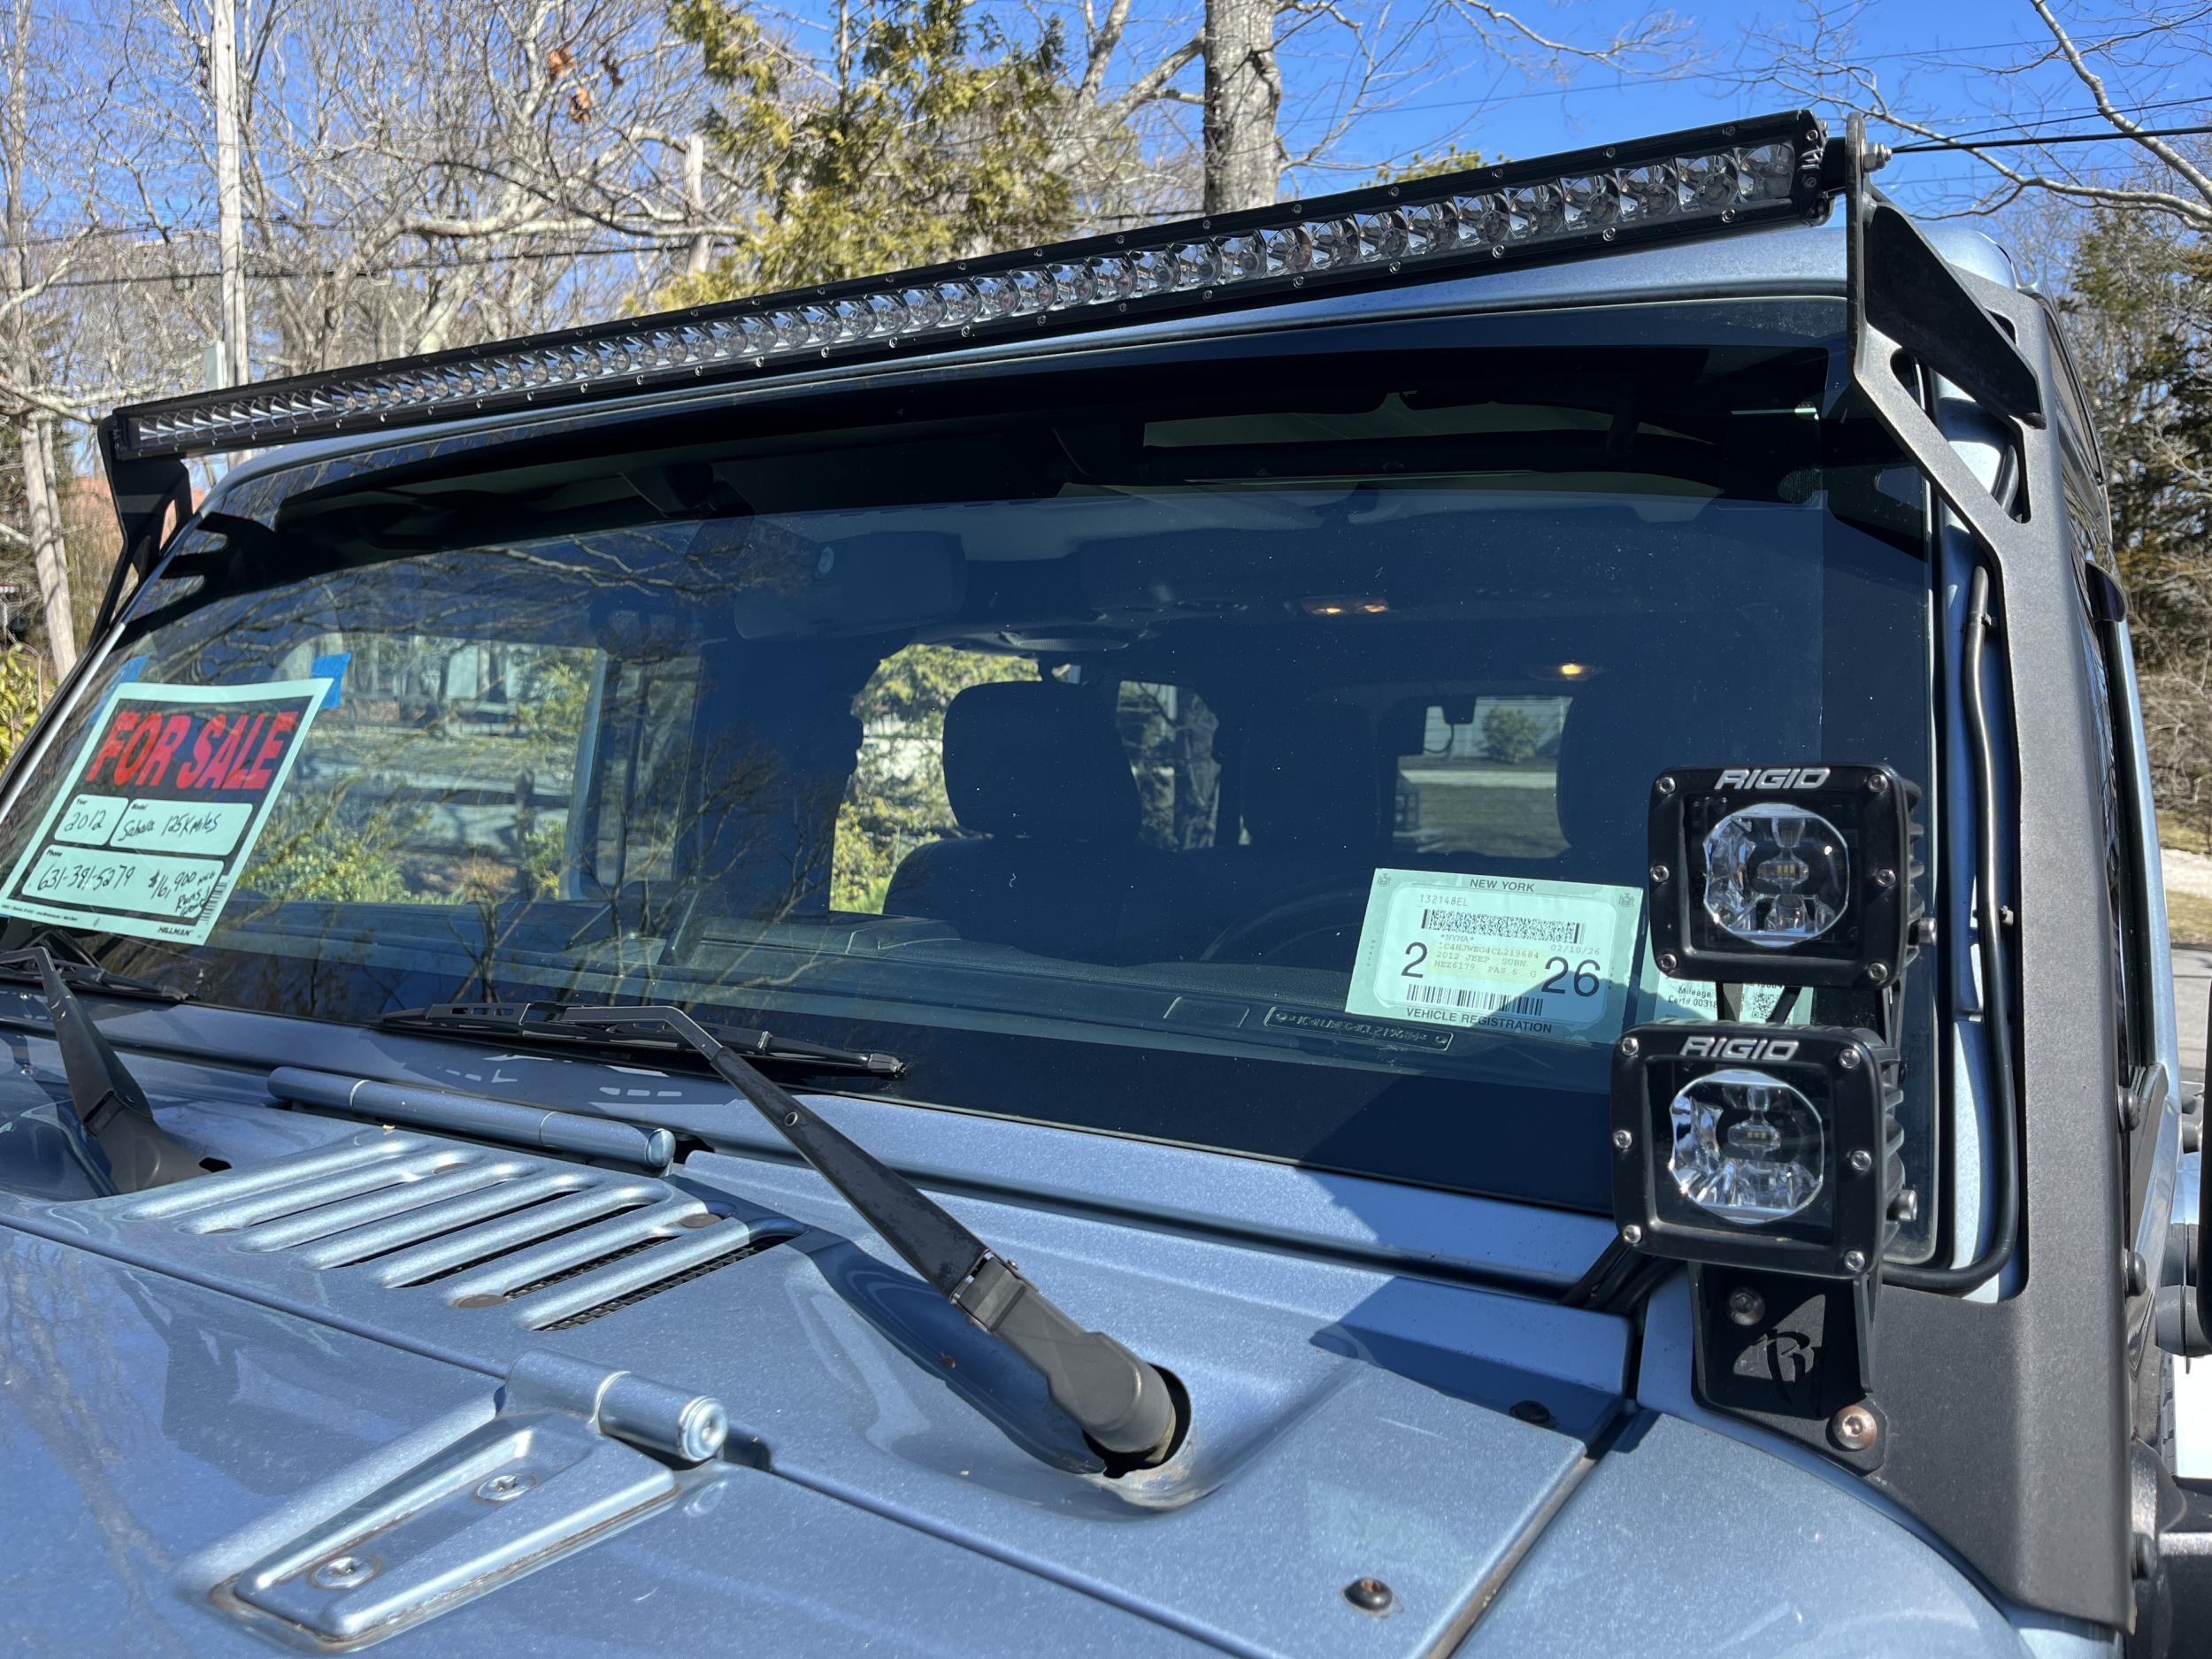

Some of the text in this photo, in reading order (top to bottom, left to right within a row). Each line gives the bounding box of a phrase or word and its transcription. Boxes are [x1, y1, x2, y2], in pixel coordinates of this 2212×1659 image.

[86, 710, 298, 789] FOR SALE
[1714, 767, 1831, 790] RIGID
[65, 810, 106, 832] 2012
[46, 848, 63, 857] Phone
[1469, 879, 1536, 893] NEW YORK
[1419, 894, 1470, 908] 132148EL
[1436, 950, 1460, 960] 2012
[1465, 954, 1490, 963] JEEP
[1550, 943, 1601, 956] 02/10/26
[1401, 941, 1428, 979] 2
[1487, 964, 1505, 973] PAS
[1541, 956, 1601, 998] 26
[1678, 986, 1711, 999] Mileage
[1407, 1007, 1552, 1033] VEHICLE REGISTRATION
[1679, 1035, 1800, 1061] RIGID
